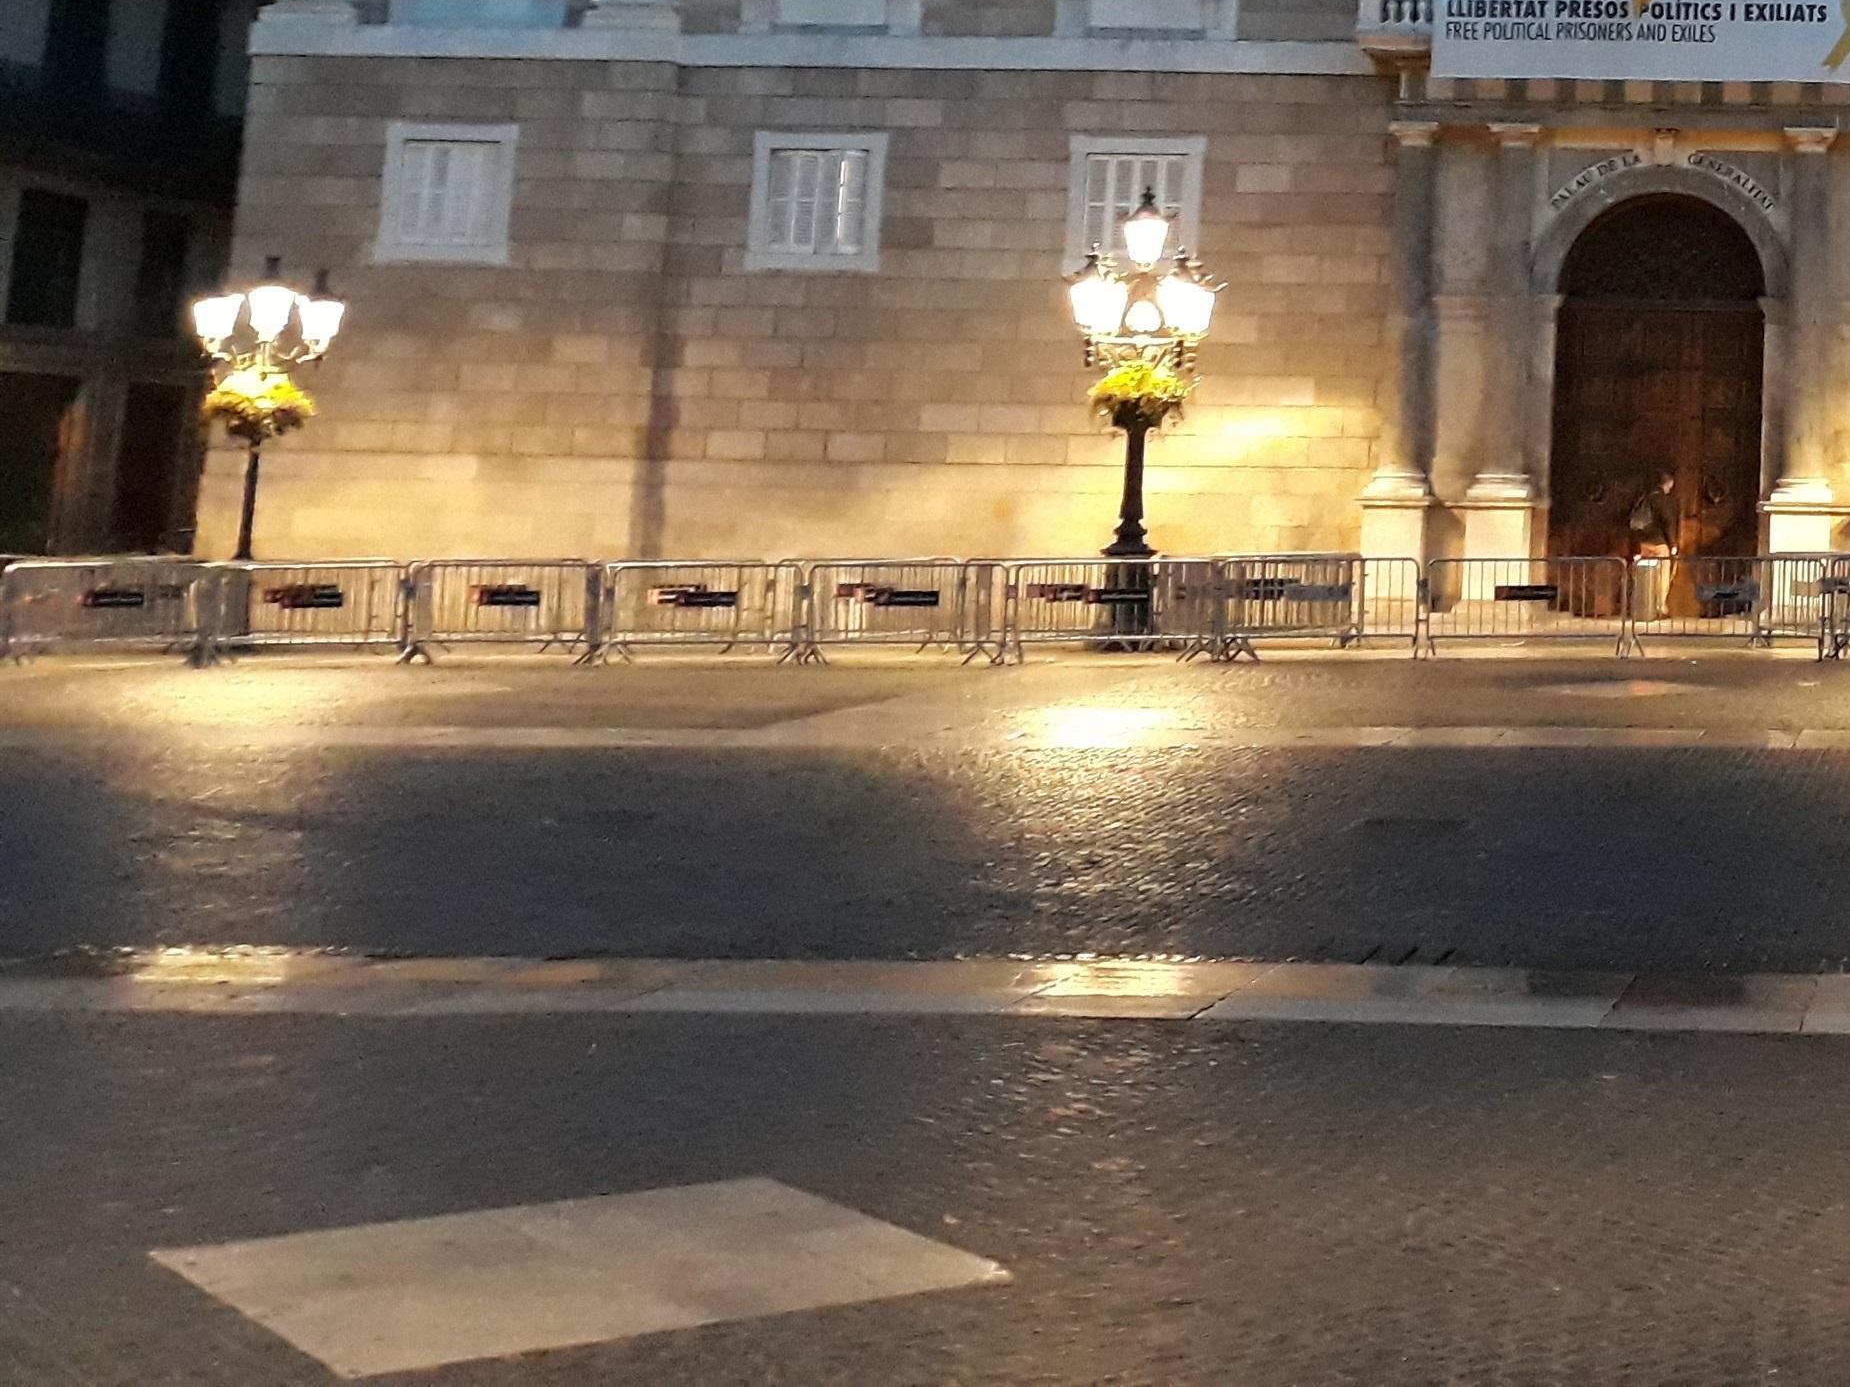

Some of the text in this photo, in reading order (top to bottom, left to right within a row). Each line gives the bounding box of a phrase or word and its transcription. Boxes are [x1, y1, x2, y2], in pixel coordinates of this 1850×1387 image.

[1447, 0, 1548, 18] LLIBERTAT
[1556, 0, 1629, 19] PRESOS
[1730, 3, 1736, 21] I
[1744, 3, 1827, 23] EXILIATS
[1446, 21, 1716, 43] FREE POLITICAL PRISONERS AND EXILES
